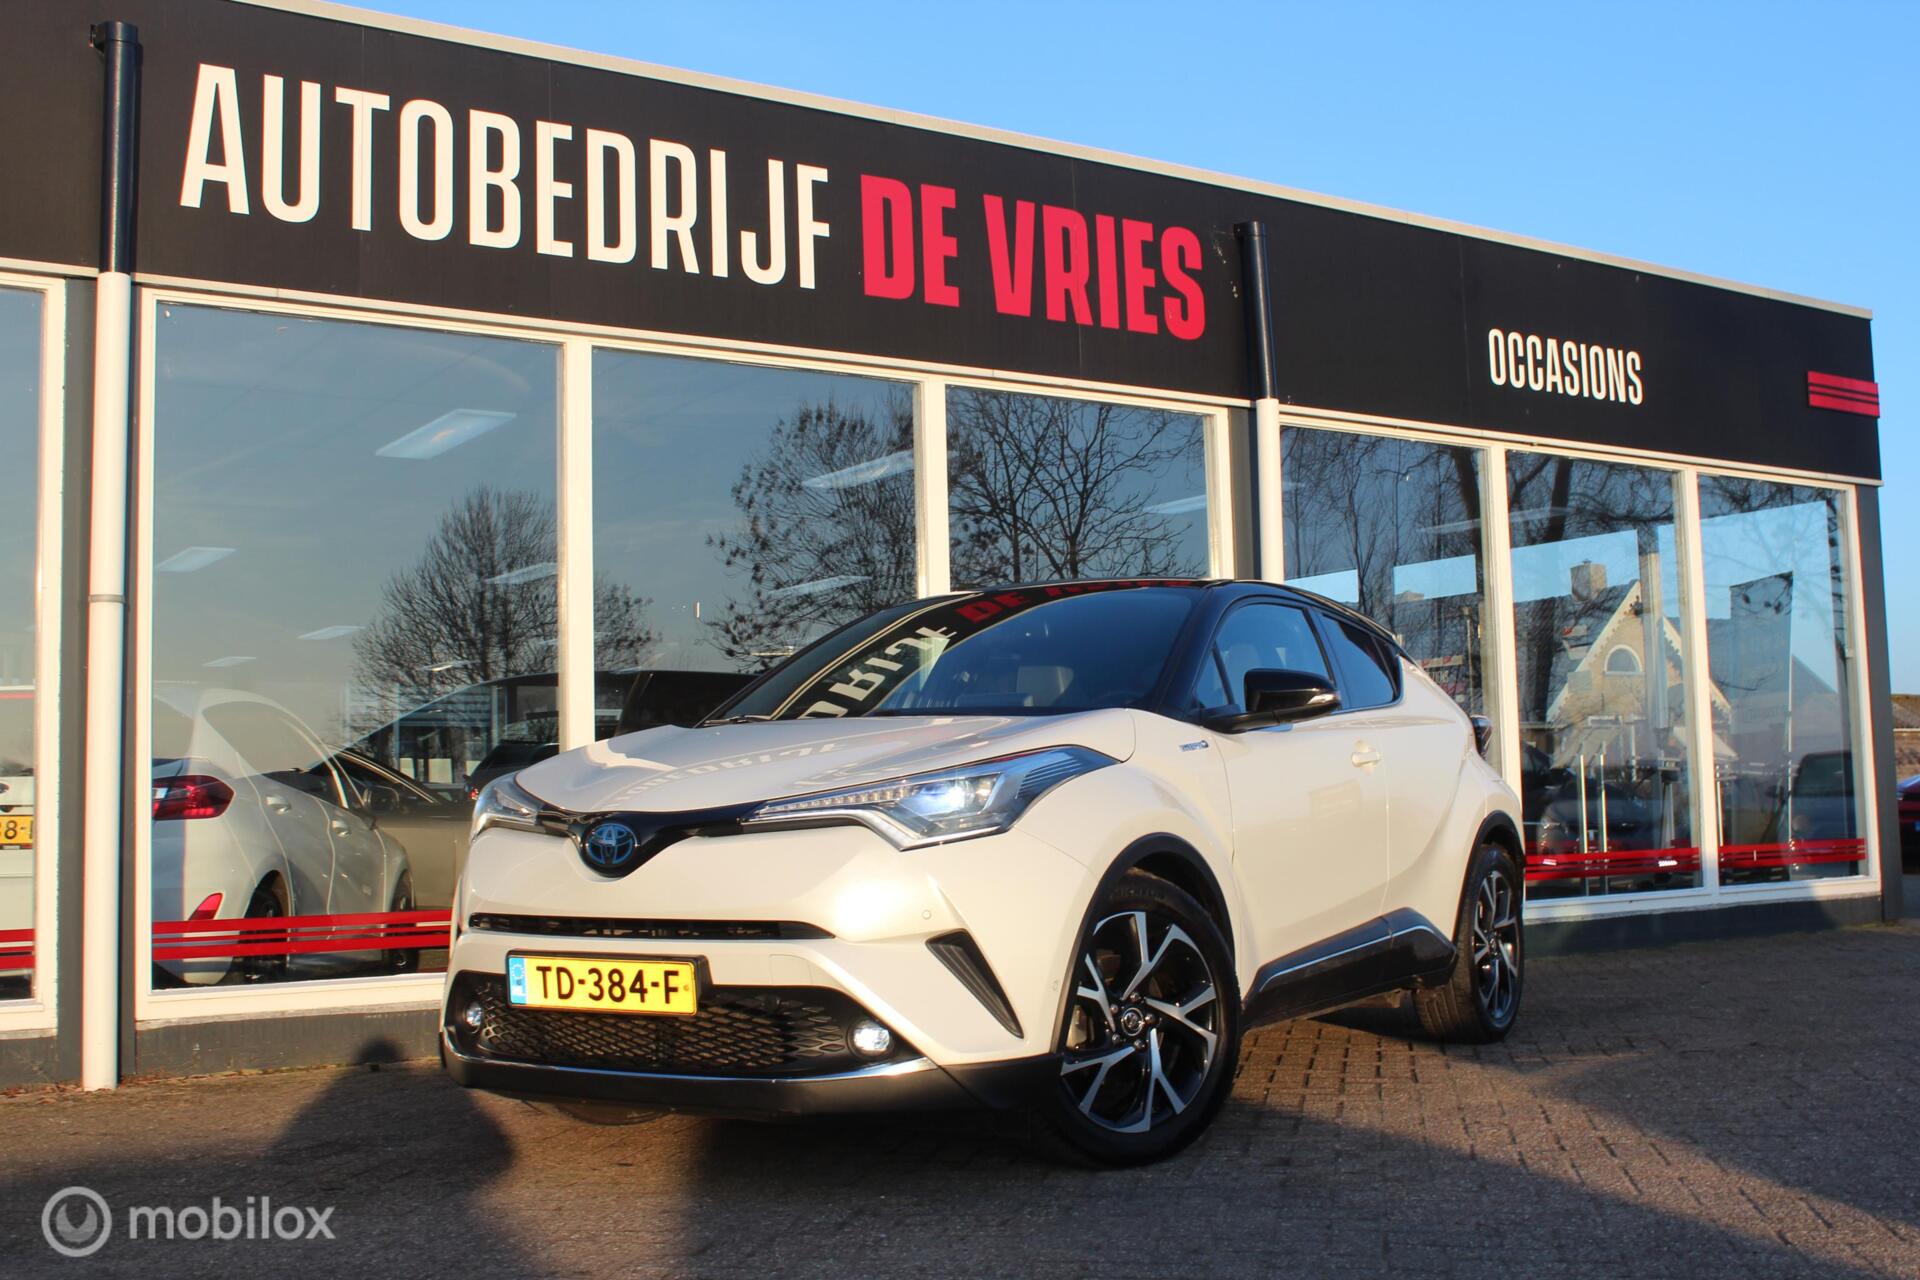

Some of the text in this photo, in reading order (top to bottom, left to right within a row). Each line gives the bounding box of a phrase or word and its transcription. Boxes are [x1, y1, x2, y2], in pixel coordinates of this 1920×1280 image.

[180, 63, 1206, 341] AUTOBEDRIJF DE VRIES
[1488, 328, 1644, 405] OCCASIONS
[535, 965, 680, 1005] TD-384-F
